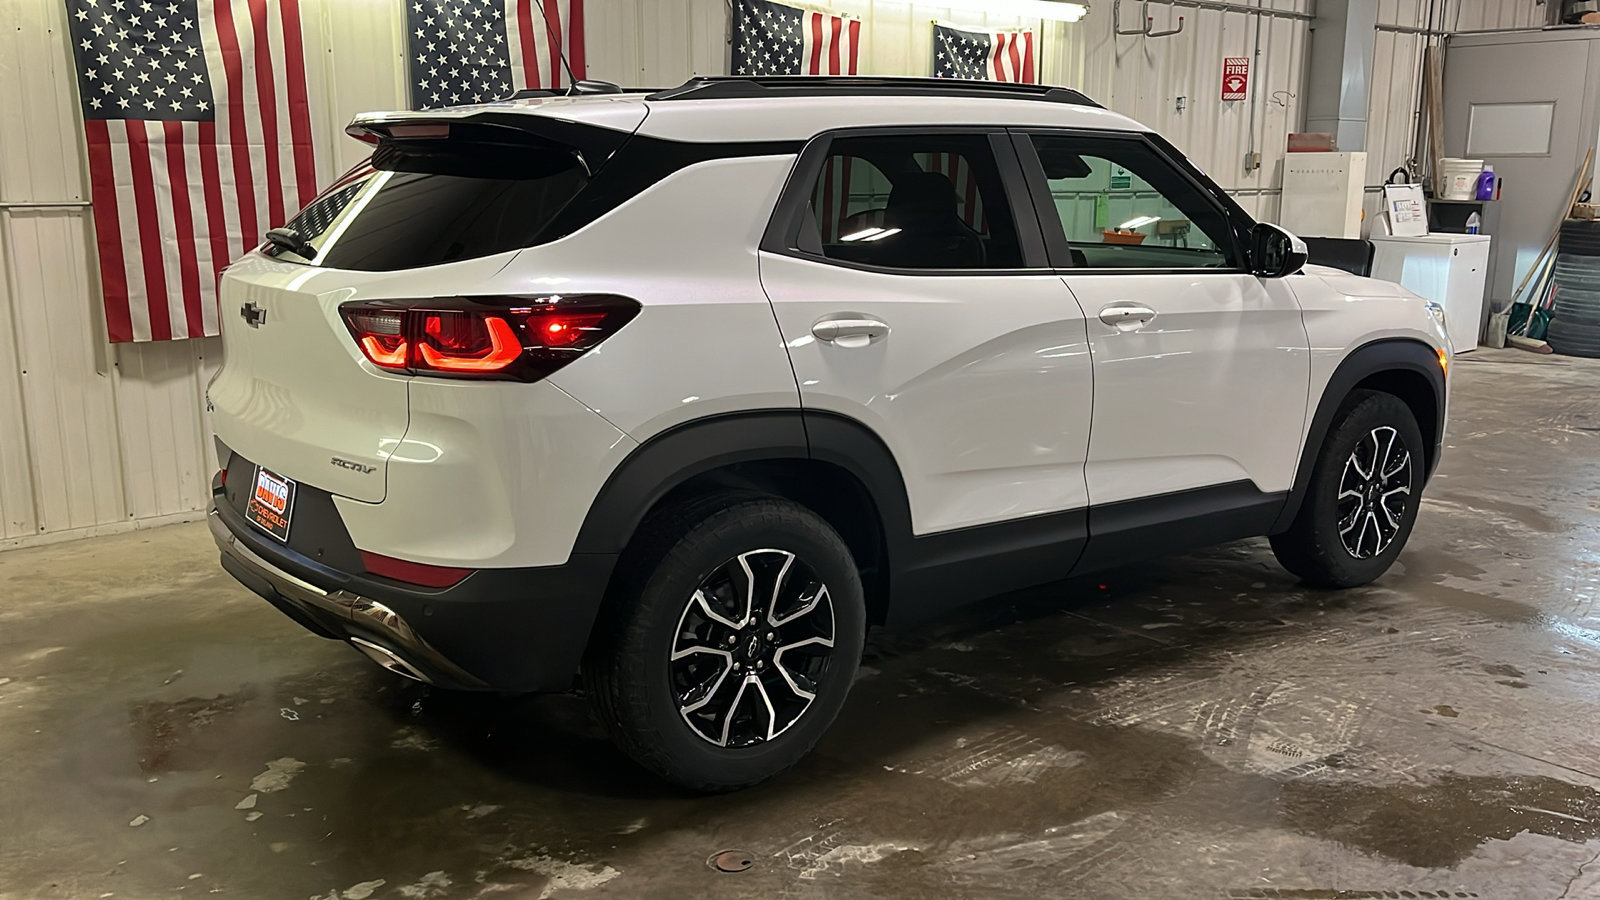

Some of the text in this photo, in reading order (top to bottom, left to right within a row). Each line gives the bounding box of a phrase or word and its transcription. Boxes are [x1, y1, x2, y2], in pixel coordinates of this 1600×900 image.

[1226, 65, 1248, 75] FIRE
[330, 457, 377, 474] ACTIV
[258, 506, 287, 528] CHEVROLET
